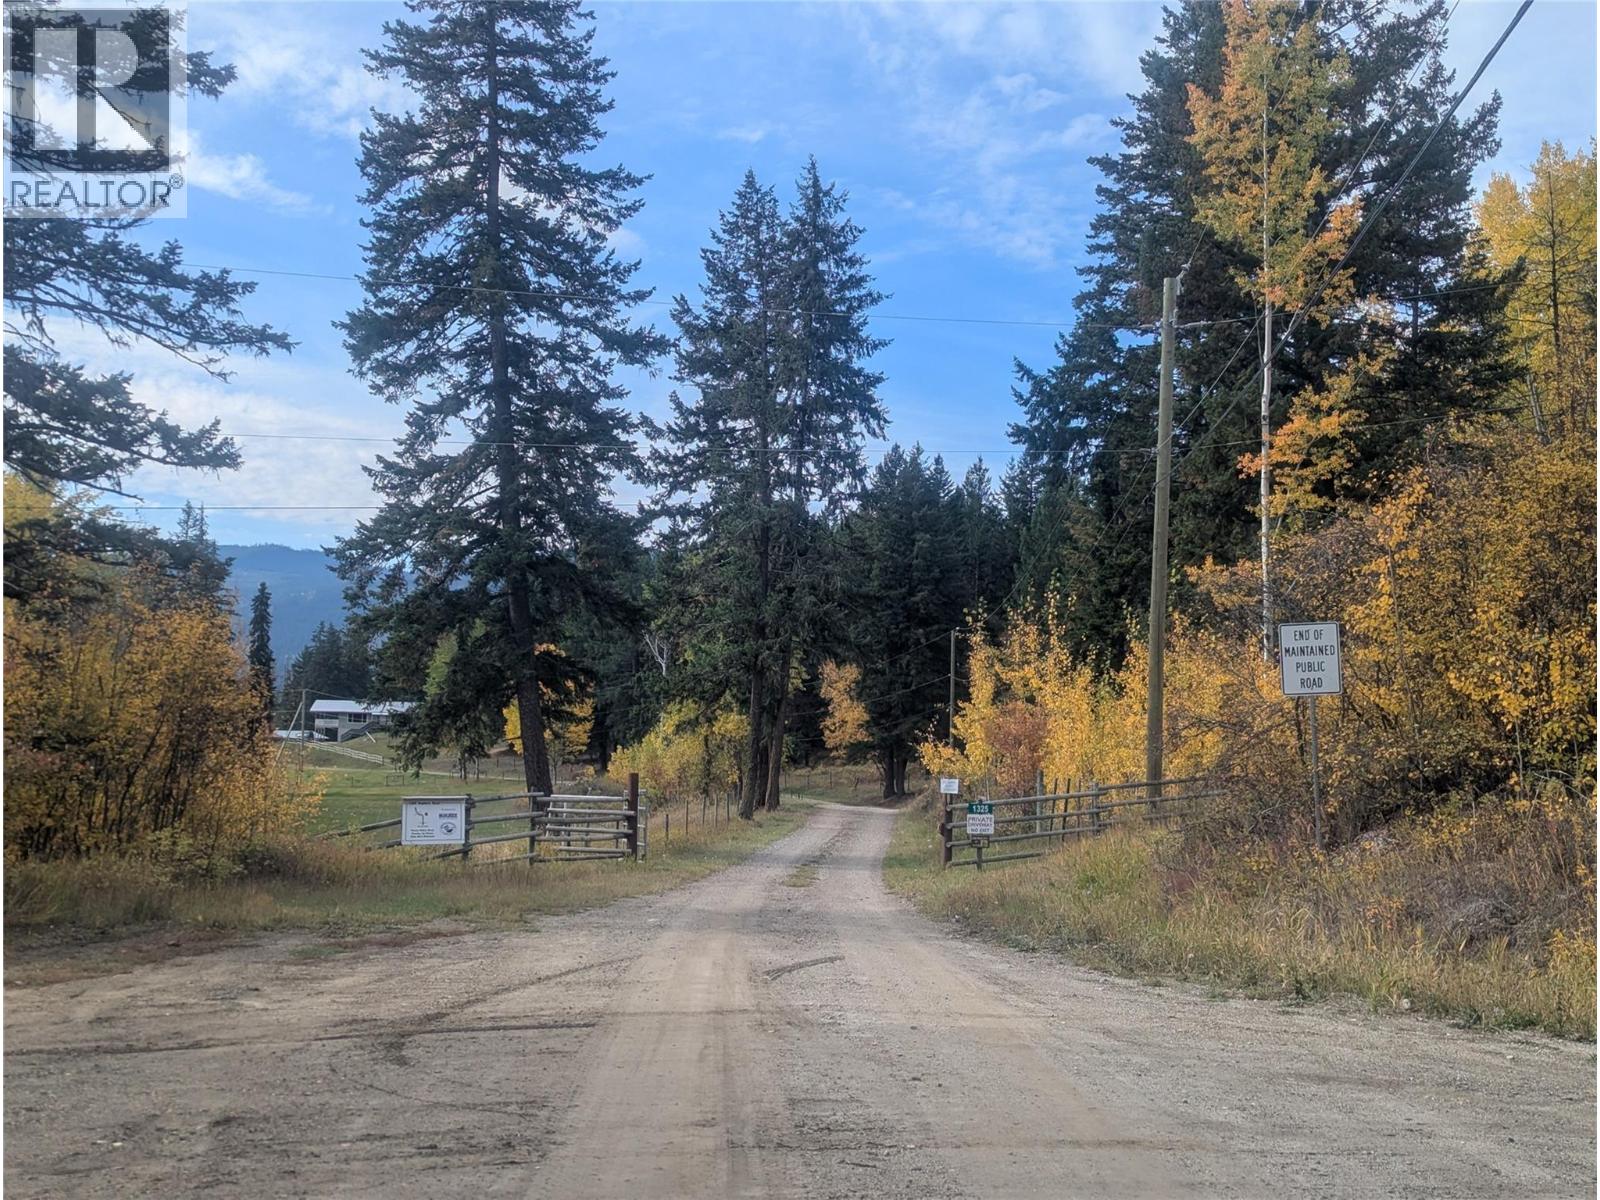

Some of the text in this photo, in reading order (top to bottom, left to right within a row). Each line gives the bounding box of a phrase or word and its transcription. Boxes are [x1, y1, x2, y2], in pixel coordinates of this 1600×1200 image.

[1294, 629, 1324, 641] END OF
[1284, 645, 1336, 657] MAINTAINED
[1296, 661, 1326, 673] PUBLIC
[1300, 677, 1323, 689] ROAD
[972, 804, 989, 813] 1325
